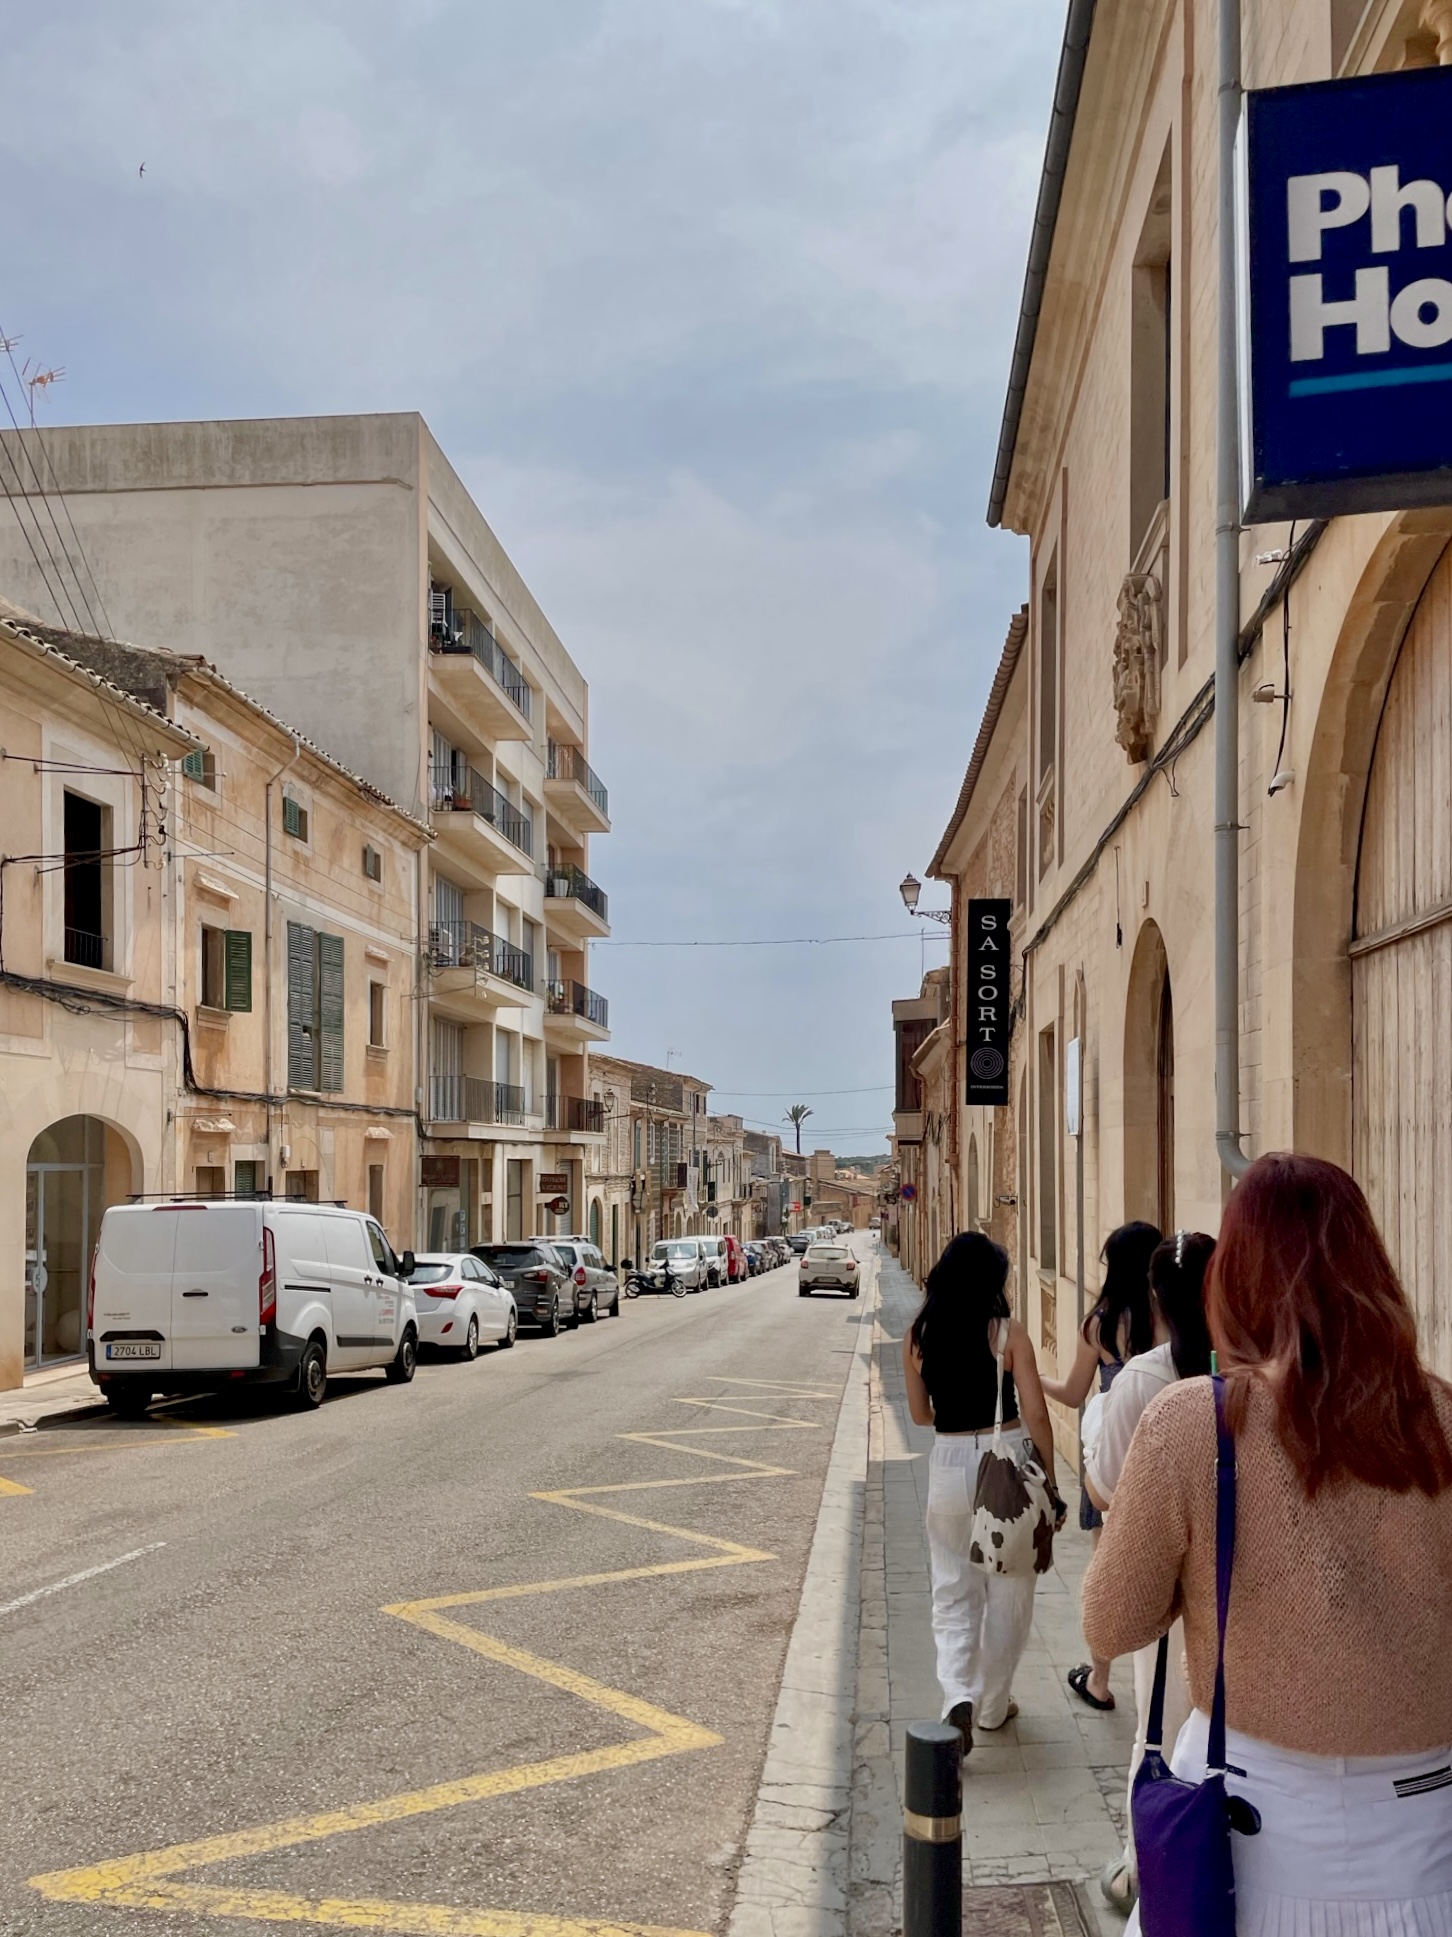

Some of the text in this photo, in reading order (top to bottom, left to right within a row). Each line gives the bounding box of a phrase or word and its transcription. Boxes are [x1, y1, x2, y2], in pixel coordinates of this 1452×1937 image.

[1287, 164, 1452, 263] Ph
[1289, 265, 1452, 362] Ho
[977, 914, 999, 1042] SA SORT
[114, 1346, 156, 1356] 2704 LBL
